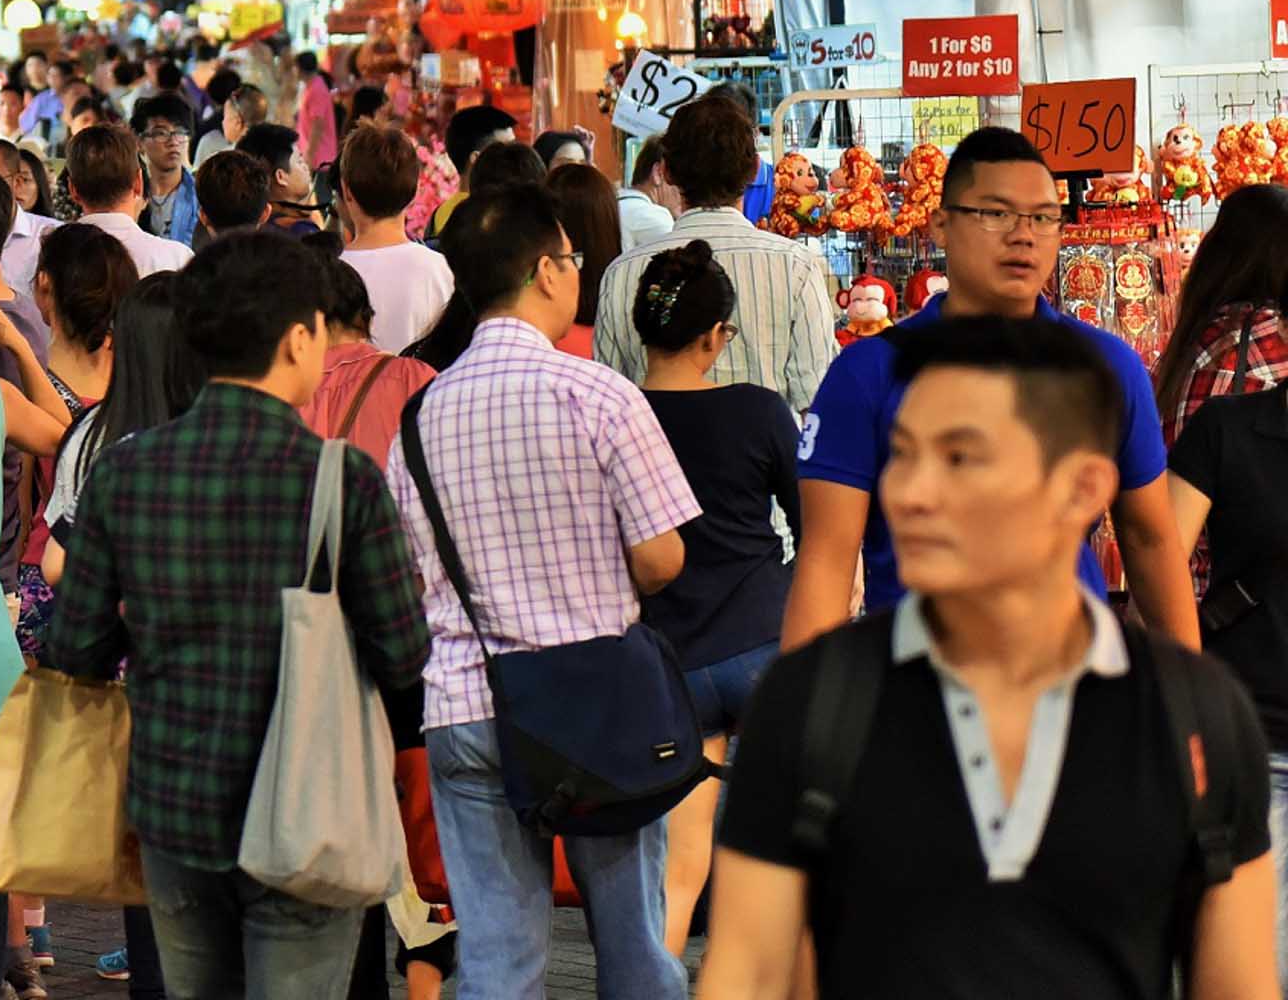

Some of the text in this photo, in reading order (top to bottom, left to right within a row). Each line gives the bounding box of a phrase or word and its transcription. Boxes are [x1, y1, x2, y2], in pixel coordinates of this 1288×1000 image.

[811, 38, 826, 64] 5
[828, 46, 844, 61] for
[929, 34, 992, 56] 1 For $6
[908, 57, 1013, 79] Any 2 for $10
[630, 58, 697, 118] $2
[1027, 96, 1127, 159] $1.50
[797, 412, 821, 462] 3
